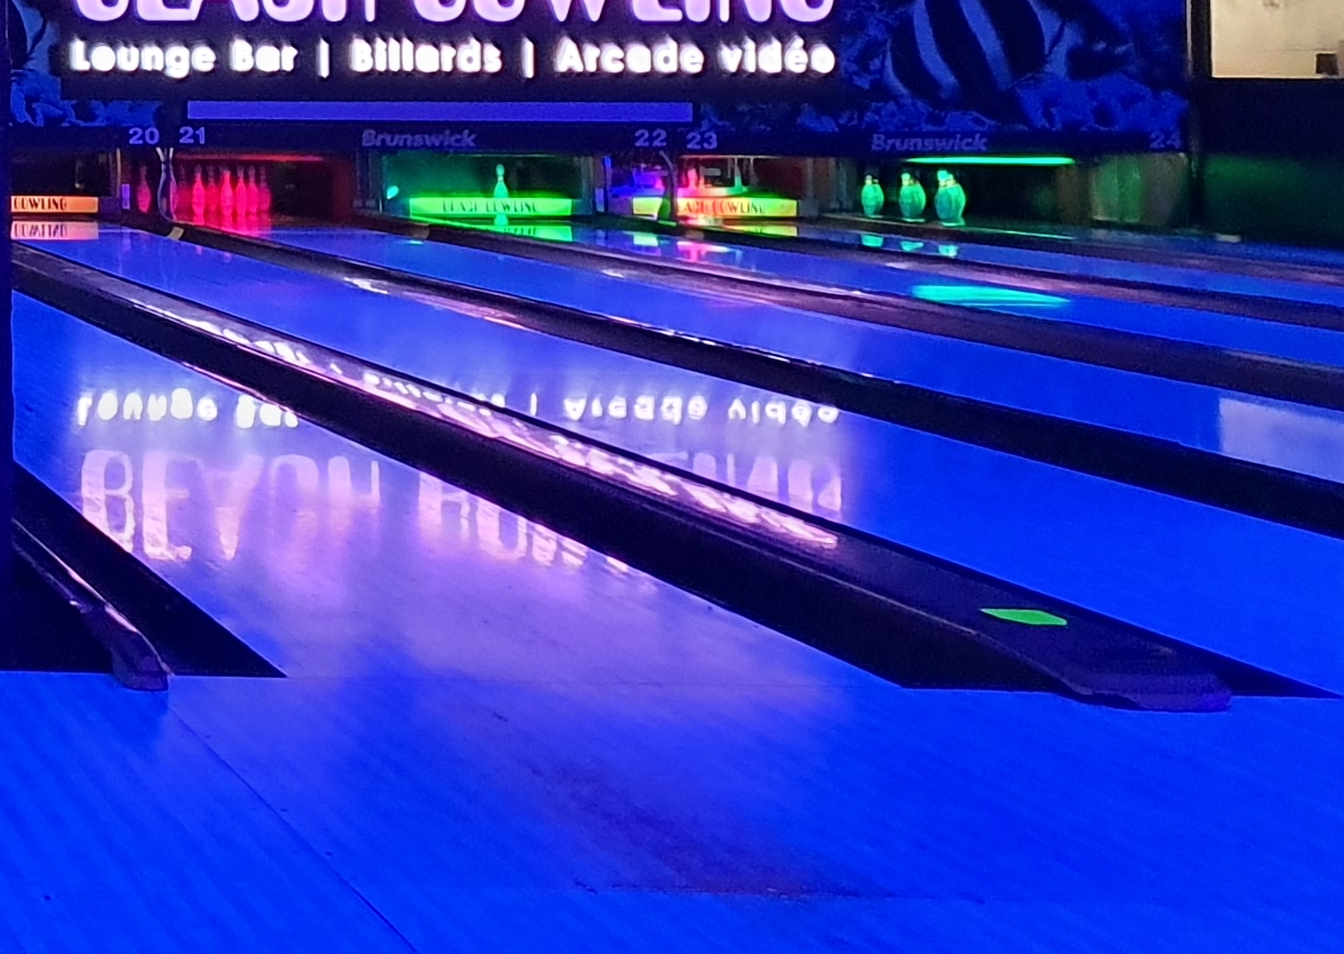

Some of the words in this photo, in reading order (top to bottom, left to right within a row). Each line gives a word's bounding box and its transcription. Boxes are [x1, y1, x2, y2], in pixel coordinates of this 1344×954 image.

[69, 39, 216, 77] Lounge
[230, 40, 298, 72] Bar
[351, 39, 502, 73] Billards
[557, 38, 704, 73] Arcade
[720, 39, 835, 73] vidéo
[128, 127, 160, 144] 20
[179, 126, 205, 144] 21
[362, 129, 476, 147] Brunswick
[634, 129, 667, 147] 22
[686, 131, 717, 149] 23
[871, 133, 988, 151] Brunswick
[1150, 132, 1180, 149] 24
